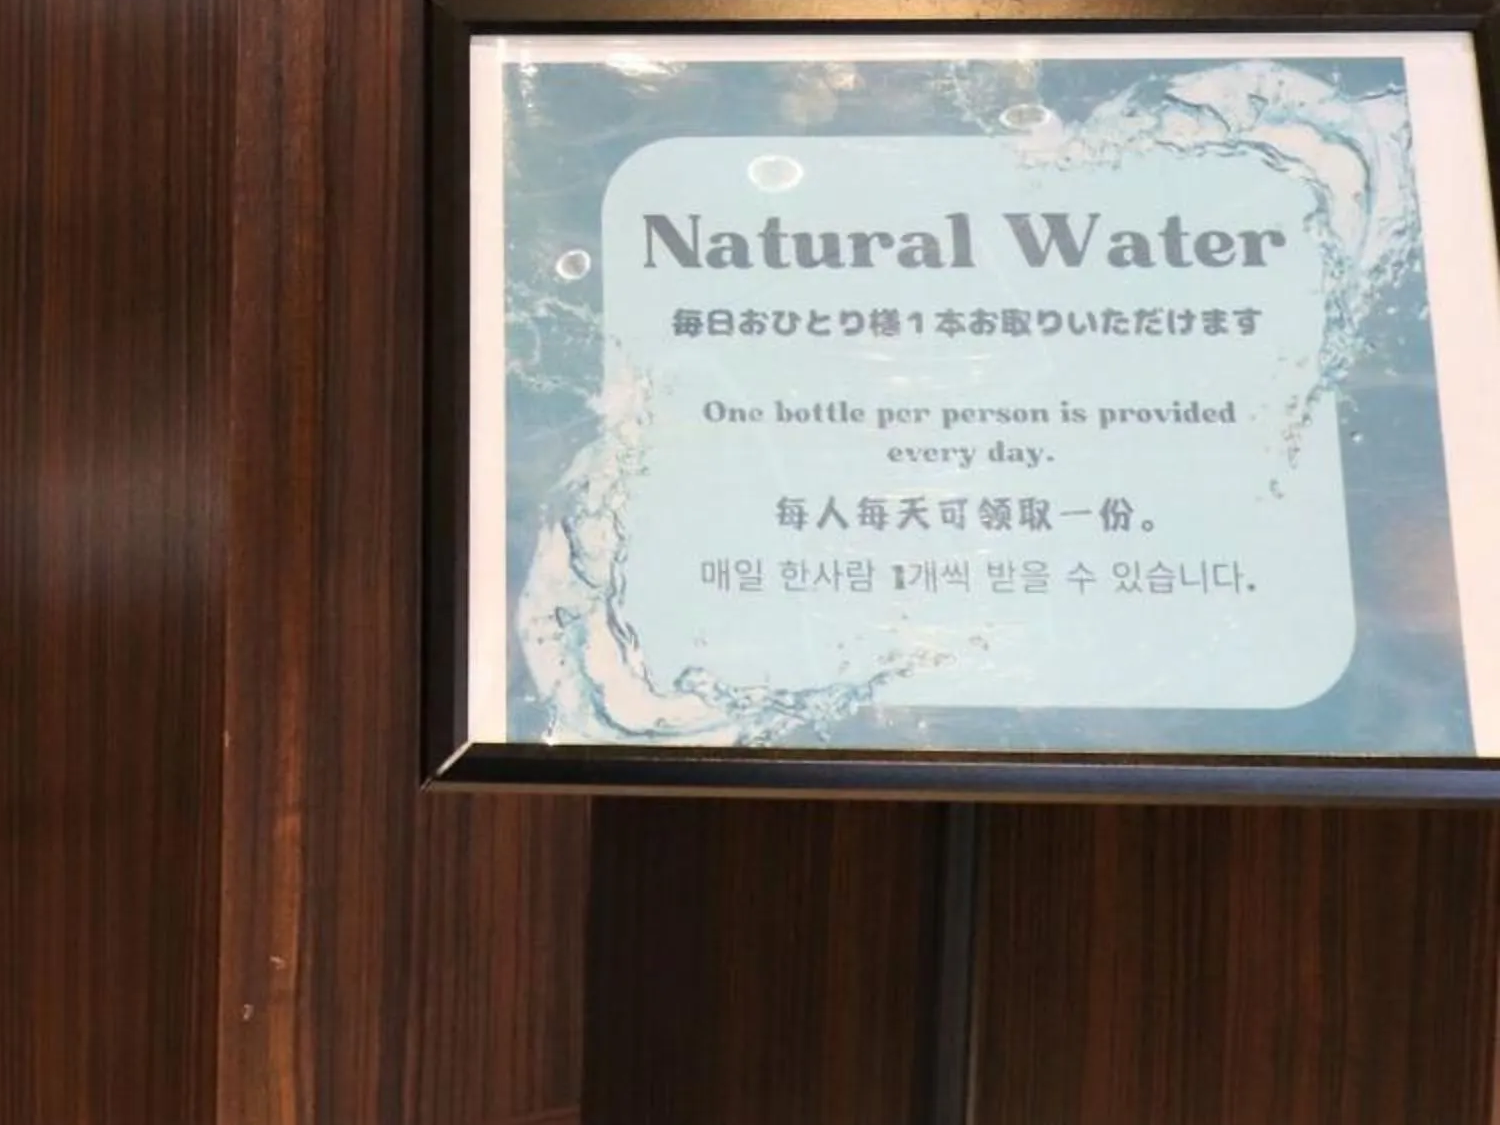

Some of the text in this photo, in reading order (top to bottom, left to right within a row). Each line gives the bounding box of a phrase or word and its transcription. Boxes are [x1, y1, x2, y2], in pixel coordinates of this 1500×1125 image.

[643, 211, 1287, 269] Natural Water
[702, 400, 1237, 430] One bottle per person is provided
[886, 440, 1056, 470] every day.
[775, 495, 1155, 532] 每人每天可领取一份。
[699, 557, 1257, 595] 매일 한사람 1개씩 받을 수 있습니다.
